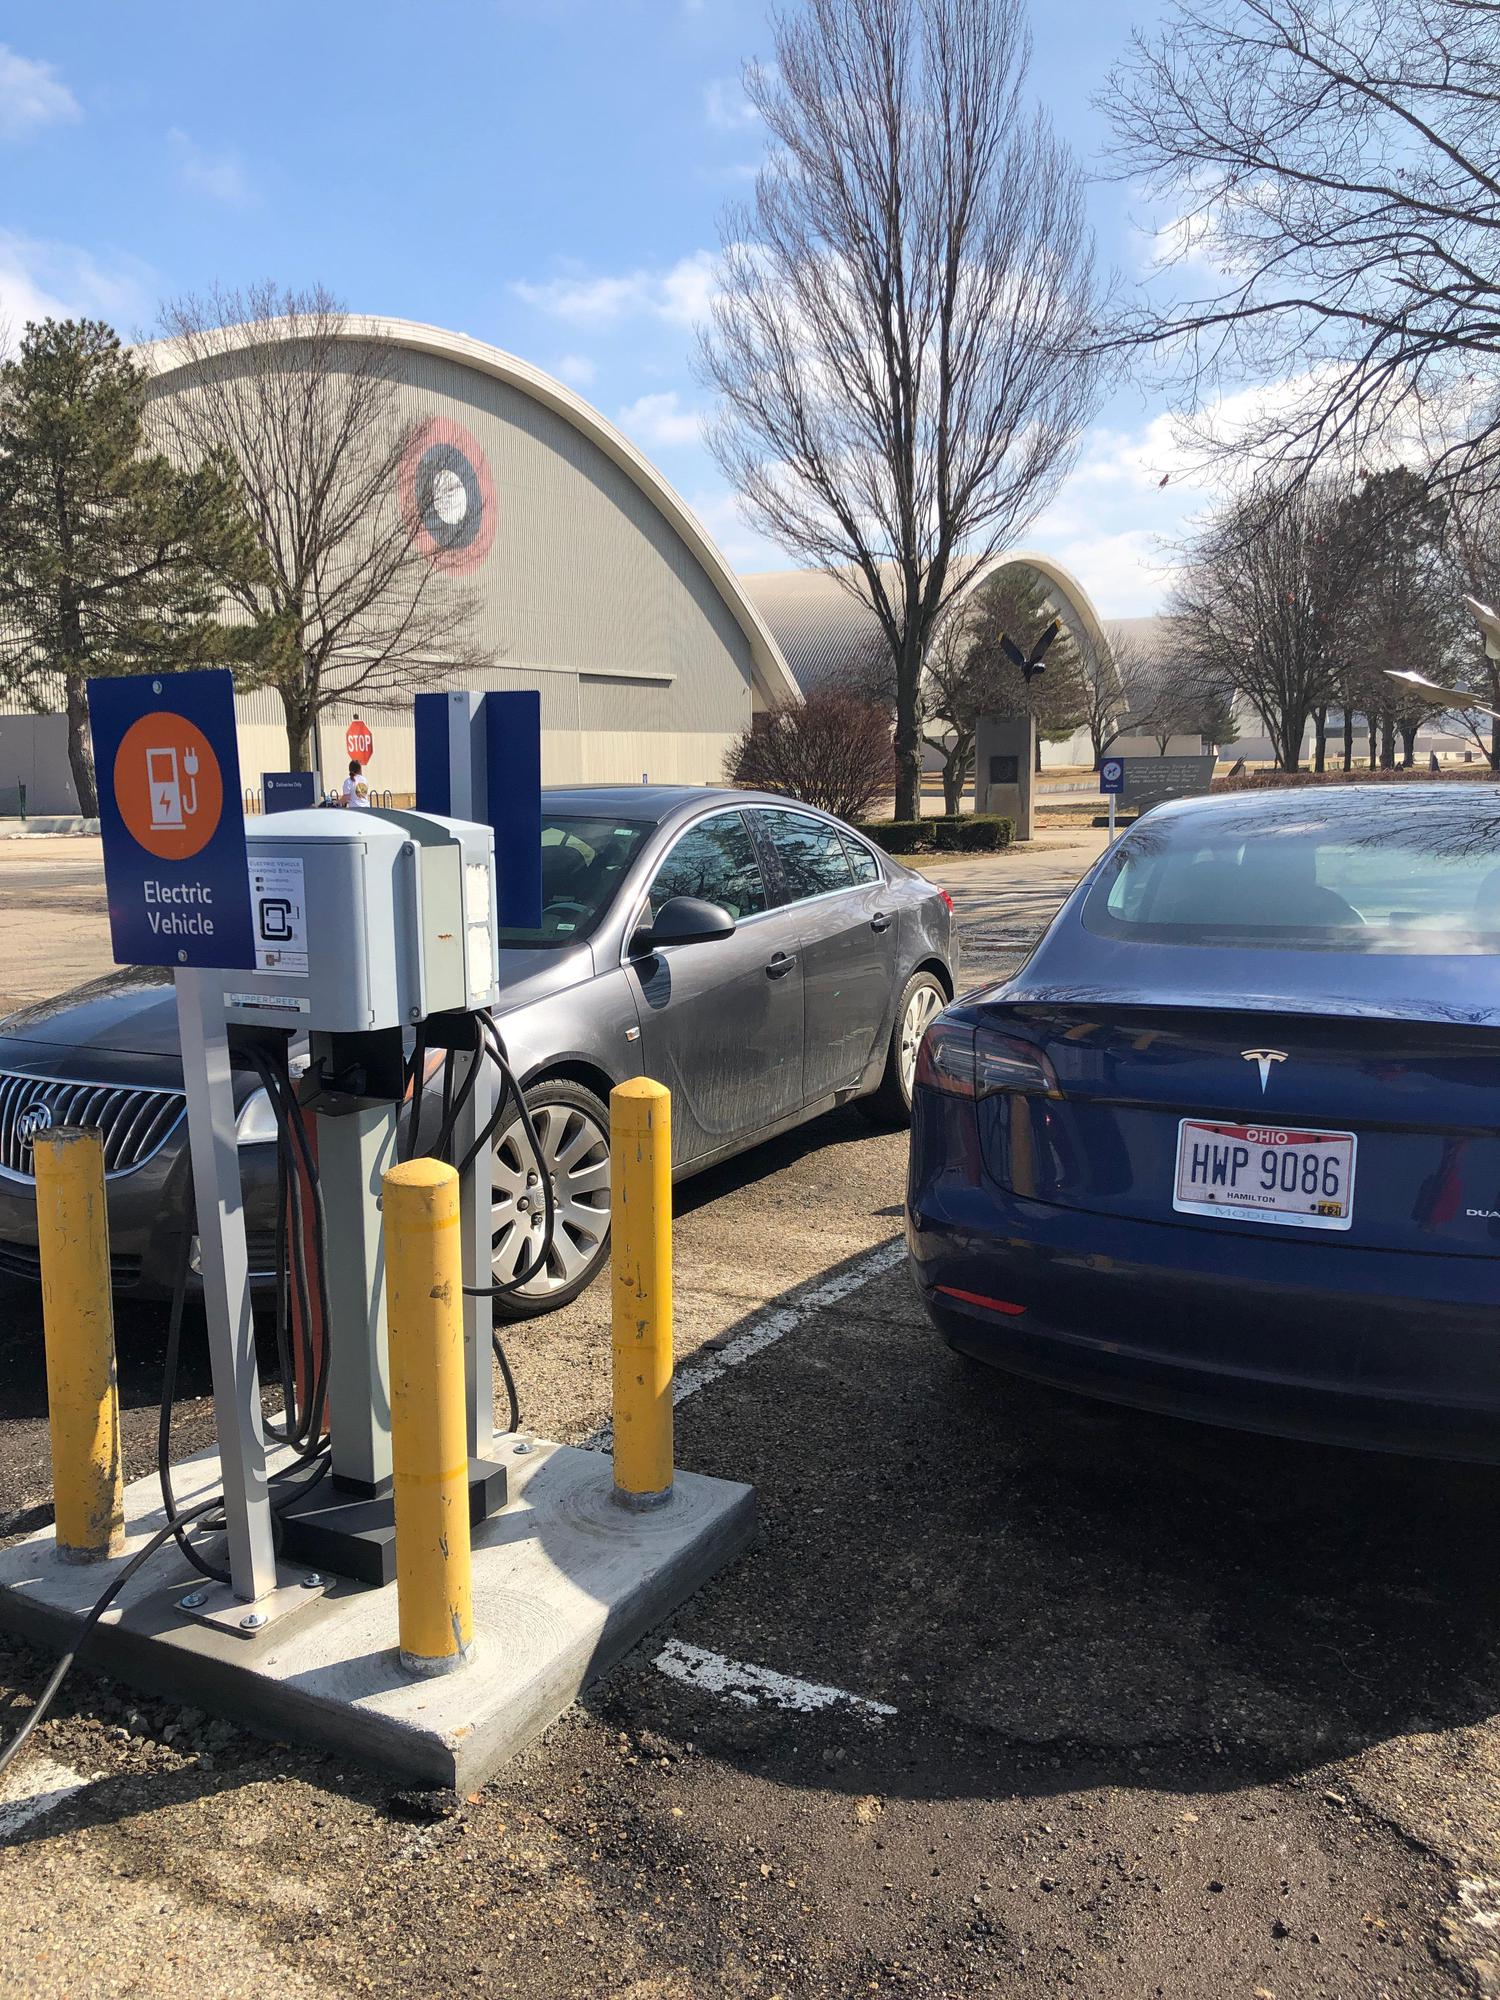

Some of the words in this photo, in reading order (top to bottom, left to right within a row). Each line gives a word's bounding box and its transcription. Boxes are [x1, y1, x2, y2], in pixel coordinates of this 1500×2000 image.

[347, 734, 371, 752] STOP
[143, 880, 213, 904] Electric
[146, 911, 214, 935] Vehicle
[1246, 1129, 1289, 1145] OHIO
[1190, 1143, 1249, 1187] HWP
[1259, 1150, 1340, 1197] 9086
[1226, 1191, 1276, 1203] HAMILTON
[1214, 1207, 1282, 1222] MODEL
[1291, 1214, 1305, 1225] 3
